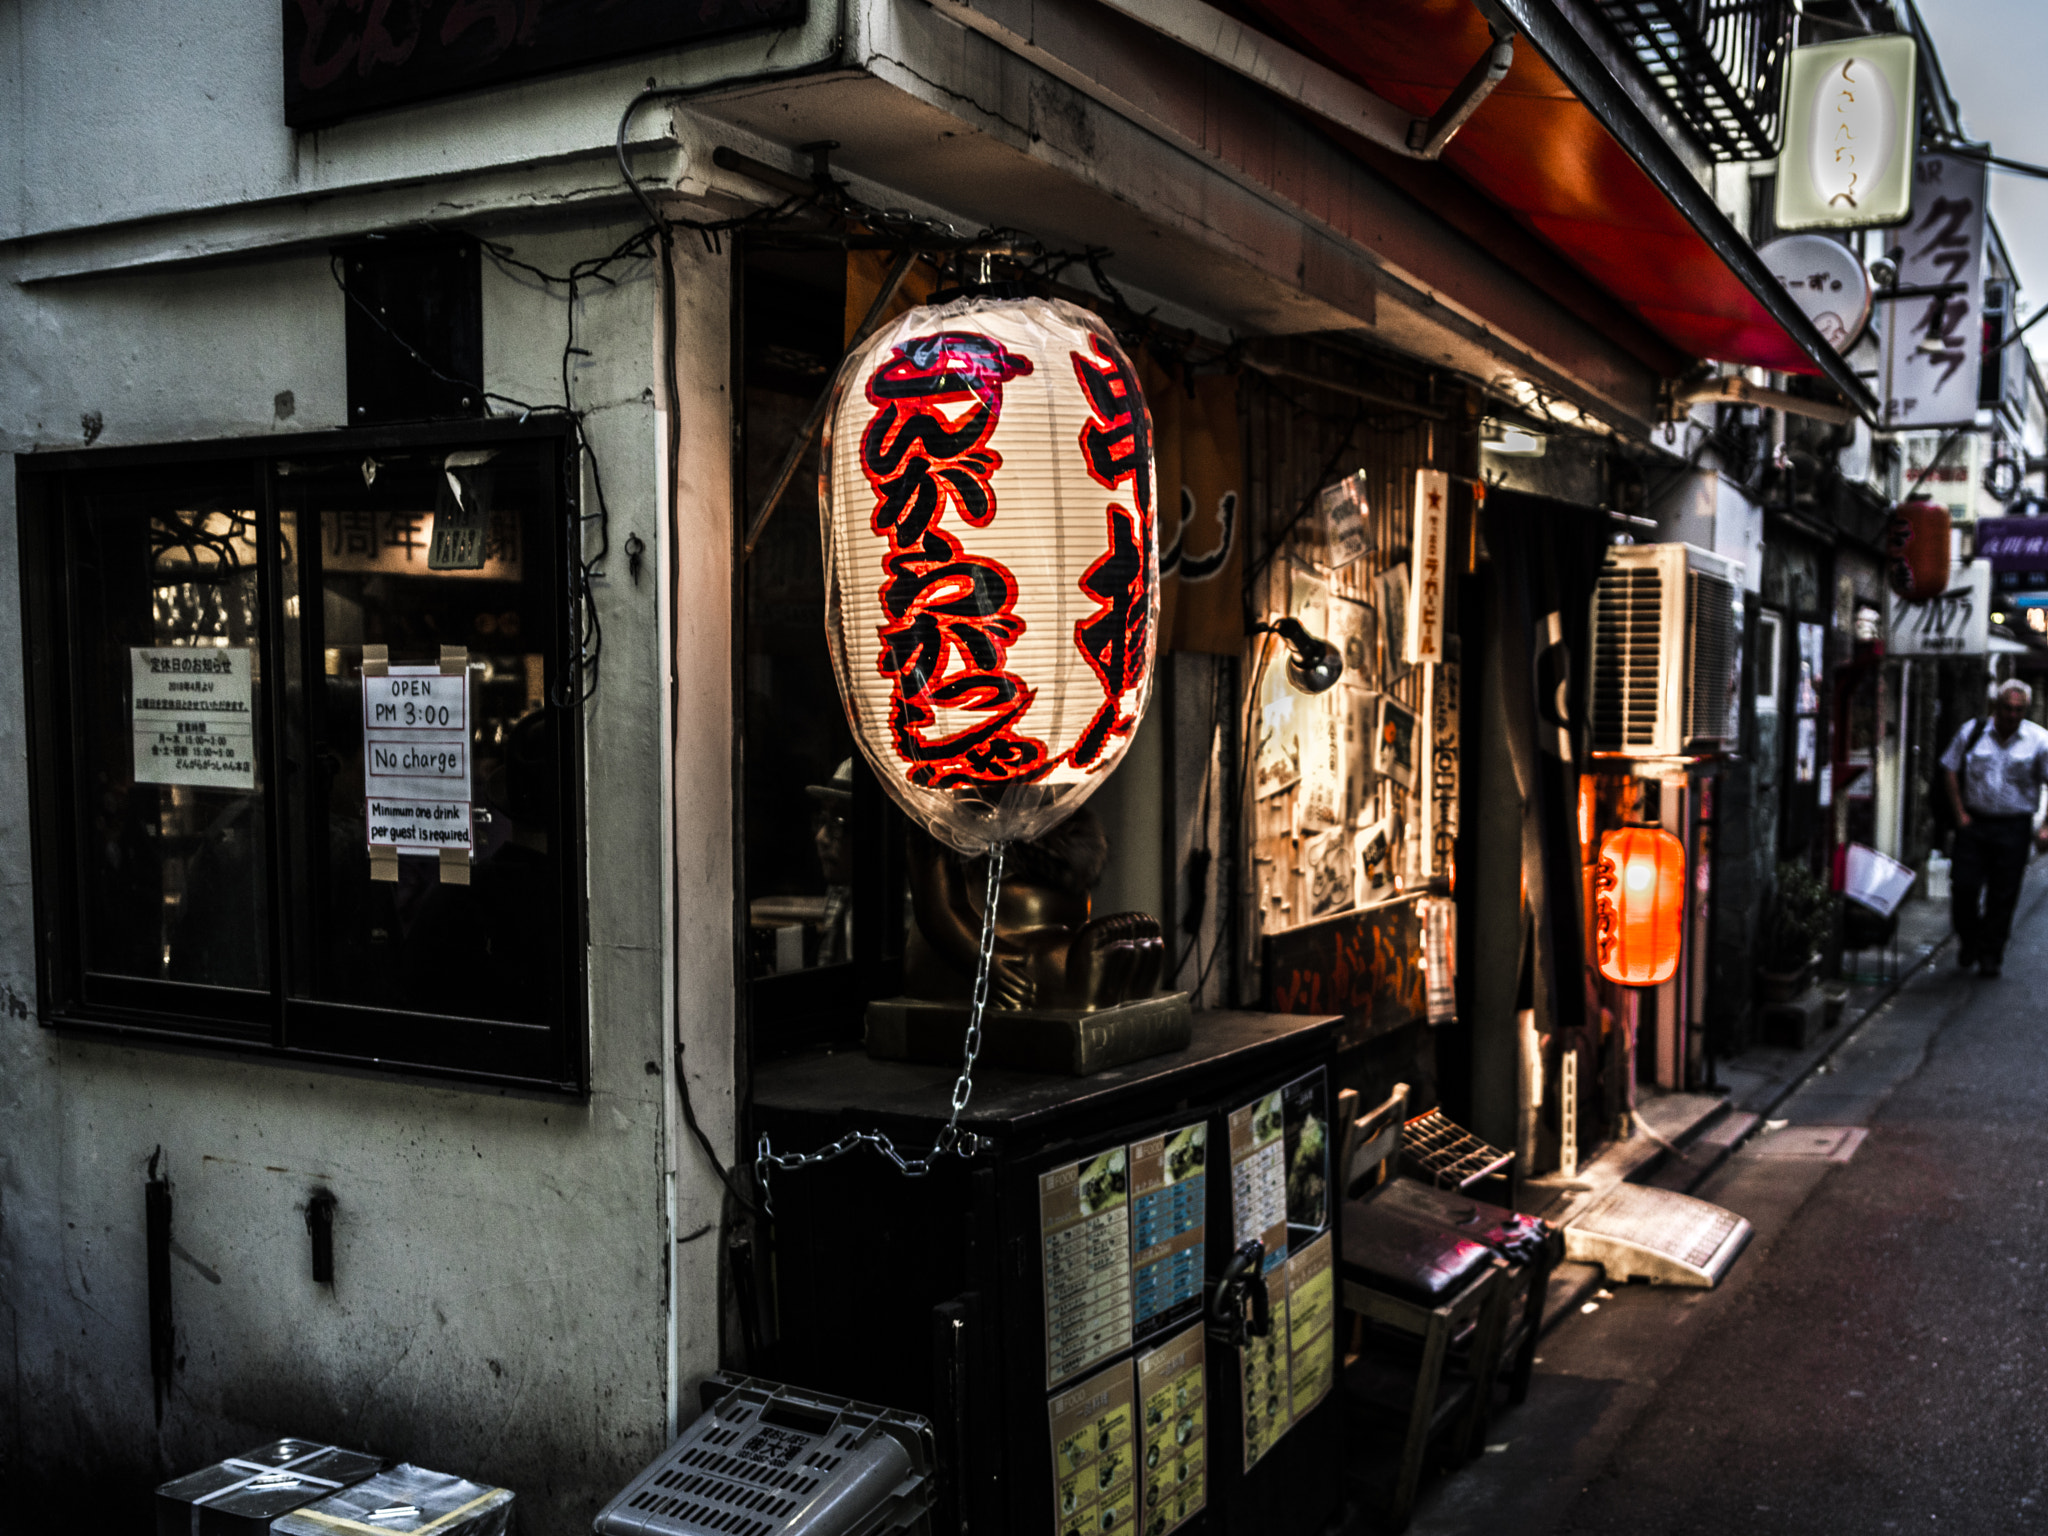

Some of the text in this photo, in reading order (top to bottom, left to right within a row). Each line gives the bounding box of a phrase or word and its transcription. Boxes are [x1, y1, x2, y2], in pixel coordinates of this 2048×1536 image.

[150, 657, 232, 674] 定休日のお知らせ
[391, 680, 431, 697] OPEN
[375, 701, 450, 726] PM 3:00
[375, 747, 457, 774] No charge
[372, 802, 460, 820] Minimum one drink
[371, 824, 388, 840] per
[389, 825, 416, 842] guest
[418, 826, 428, 841] is
